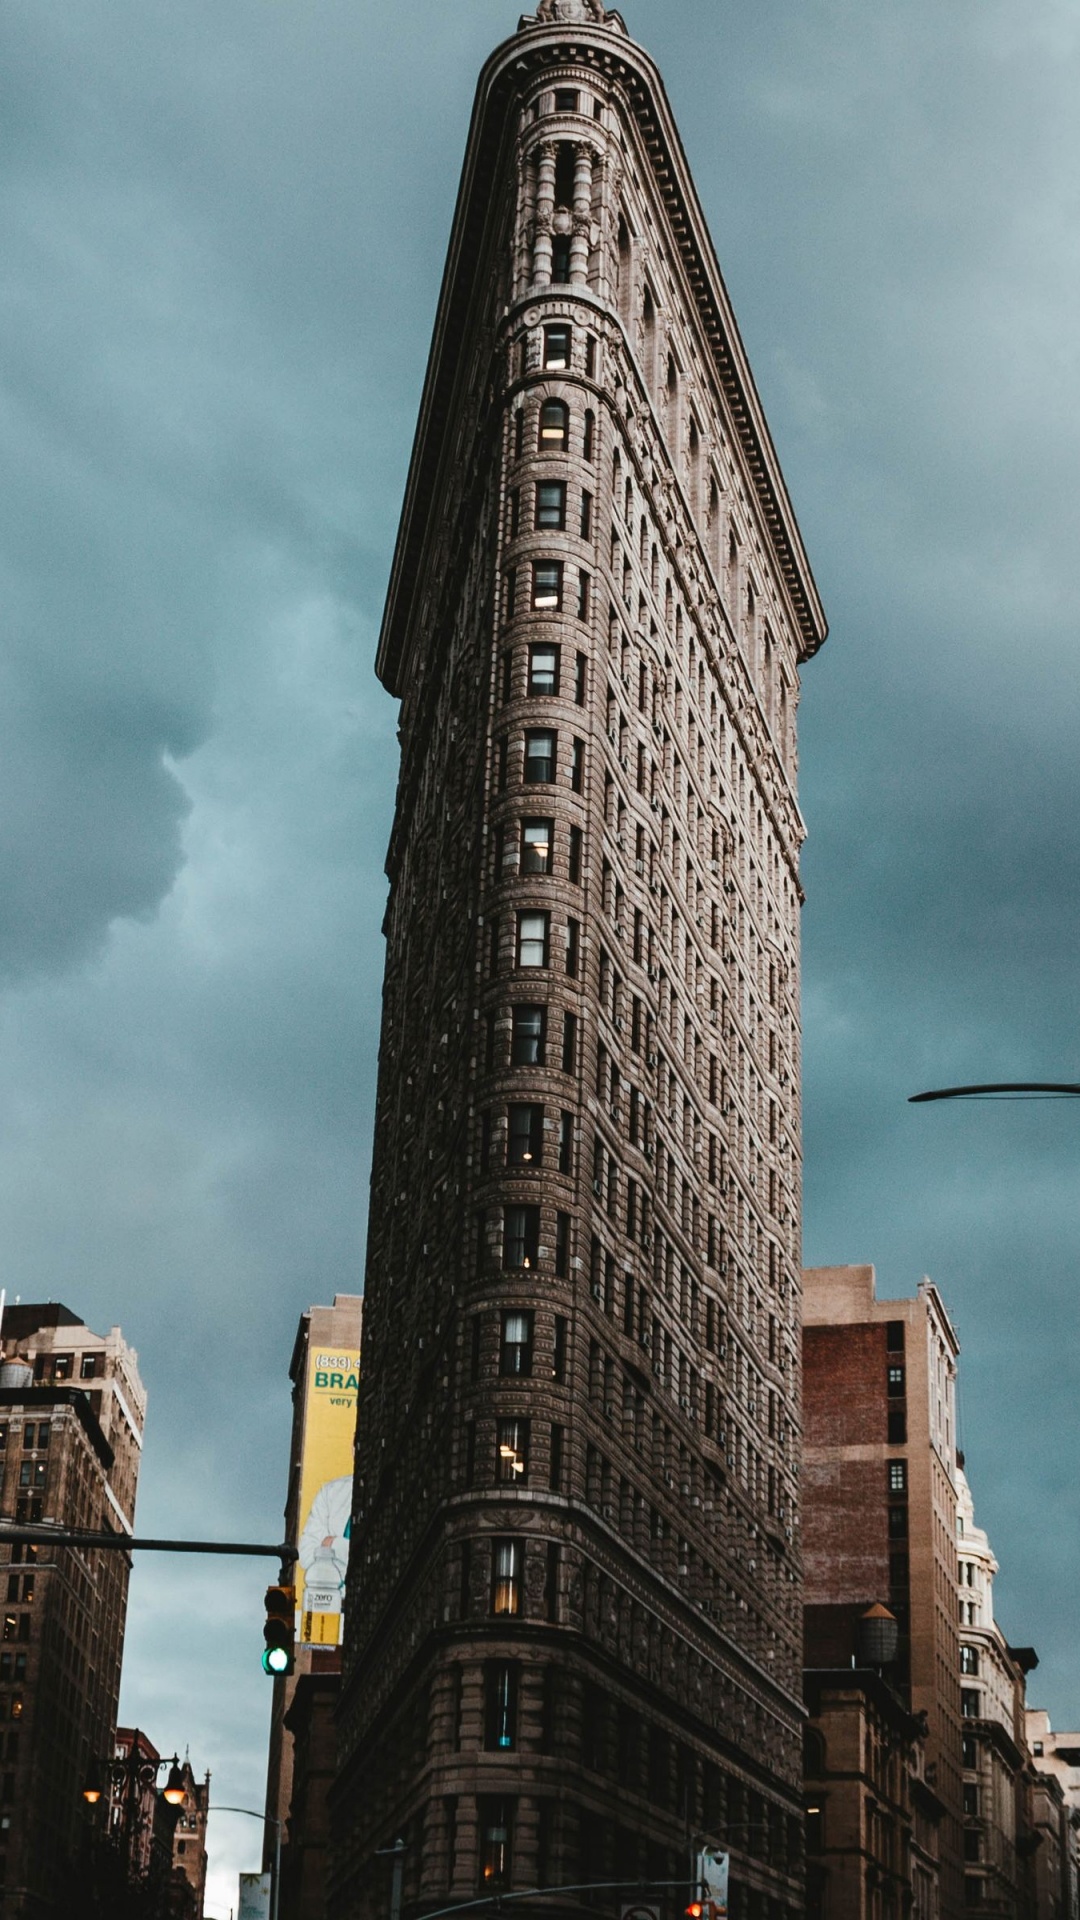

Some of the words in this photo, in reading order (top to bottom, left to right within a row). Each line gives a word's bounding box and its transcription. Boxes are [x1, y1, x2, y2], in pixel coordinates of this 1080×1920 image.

[316, 1355, 351, 1371] (833)
[315, 1372, 358, 1389] BRA
[330, 1397, 352, 1408] very
[314, 1594, 332, 1602] zero
